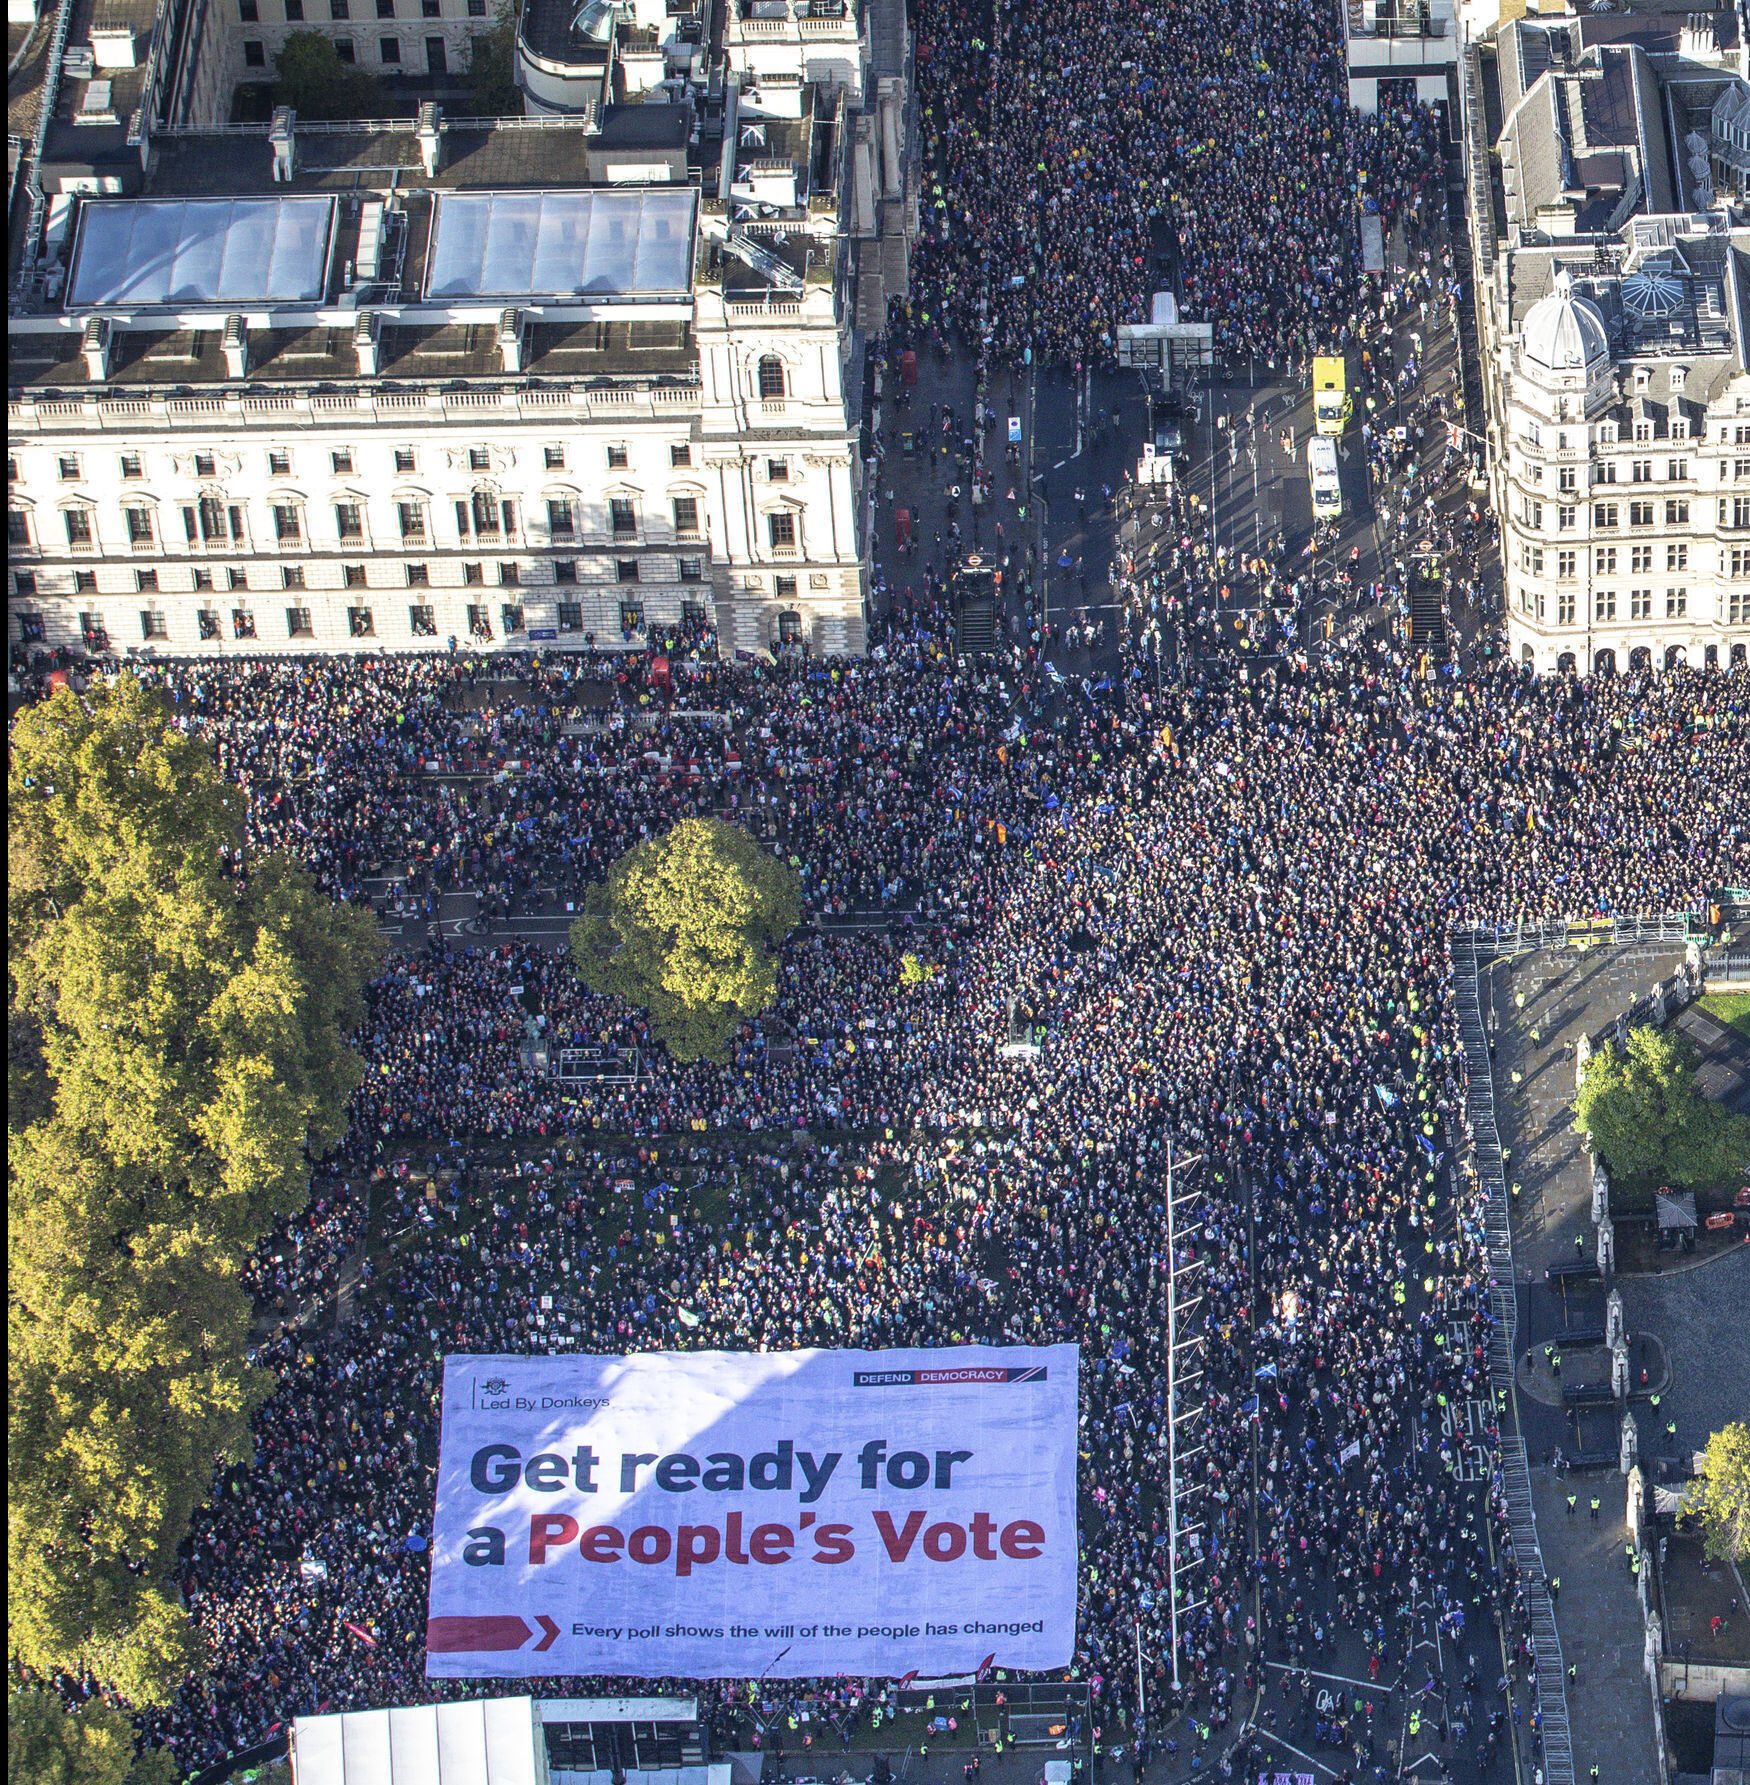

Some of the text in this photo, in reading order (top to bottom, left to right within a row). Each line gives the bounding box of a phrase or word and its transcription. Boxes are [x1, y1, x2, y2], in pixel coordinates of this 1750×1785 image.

[859, 1370, 1004, 1384] DEFEND DEMOCRACY
[480, 1396, 611, 1411] Led By Donkeys
[470, 1439, 975, 1504] Get ready for
[462, 1510, 1046, 1577] a People's Vote
[571, 1619, 1044, 1640] Every poll shows the will of the people has changed
